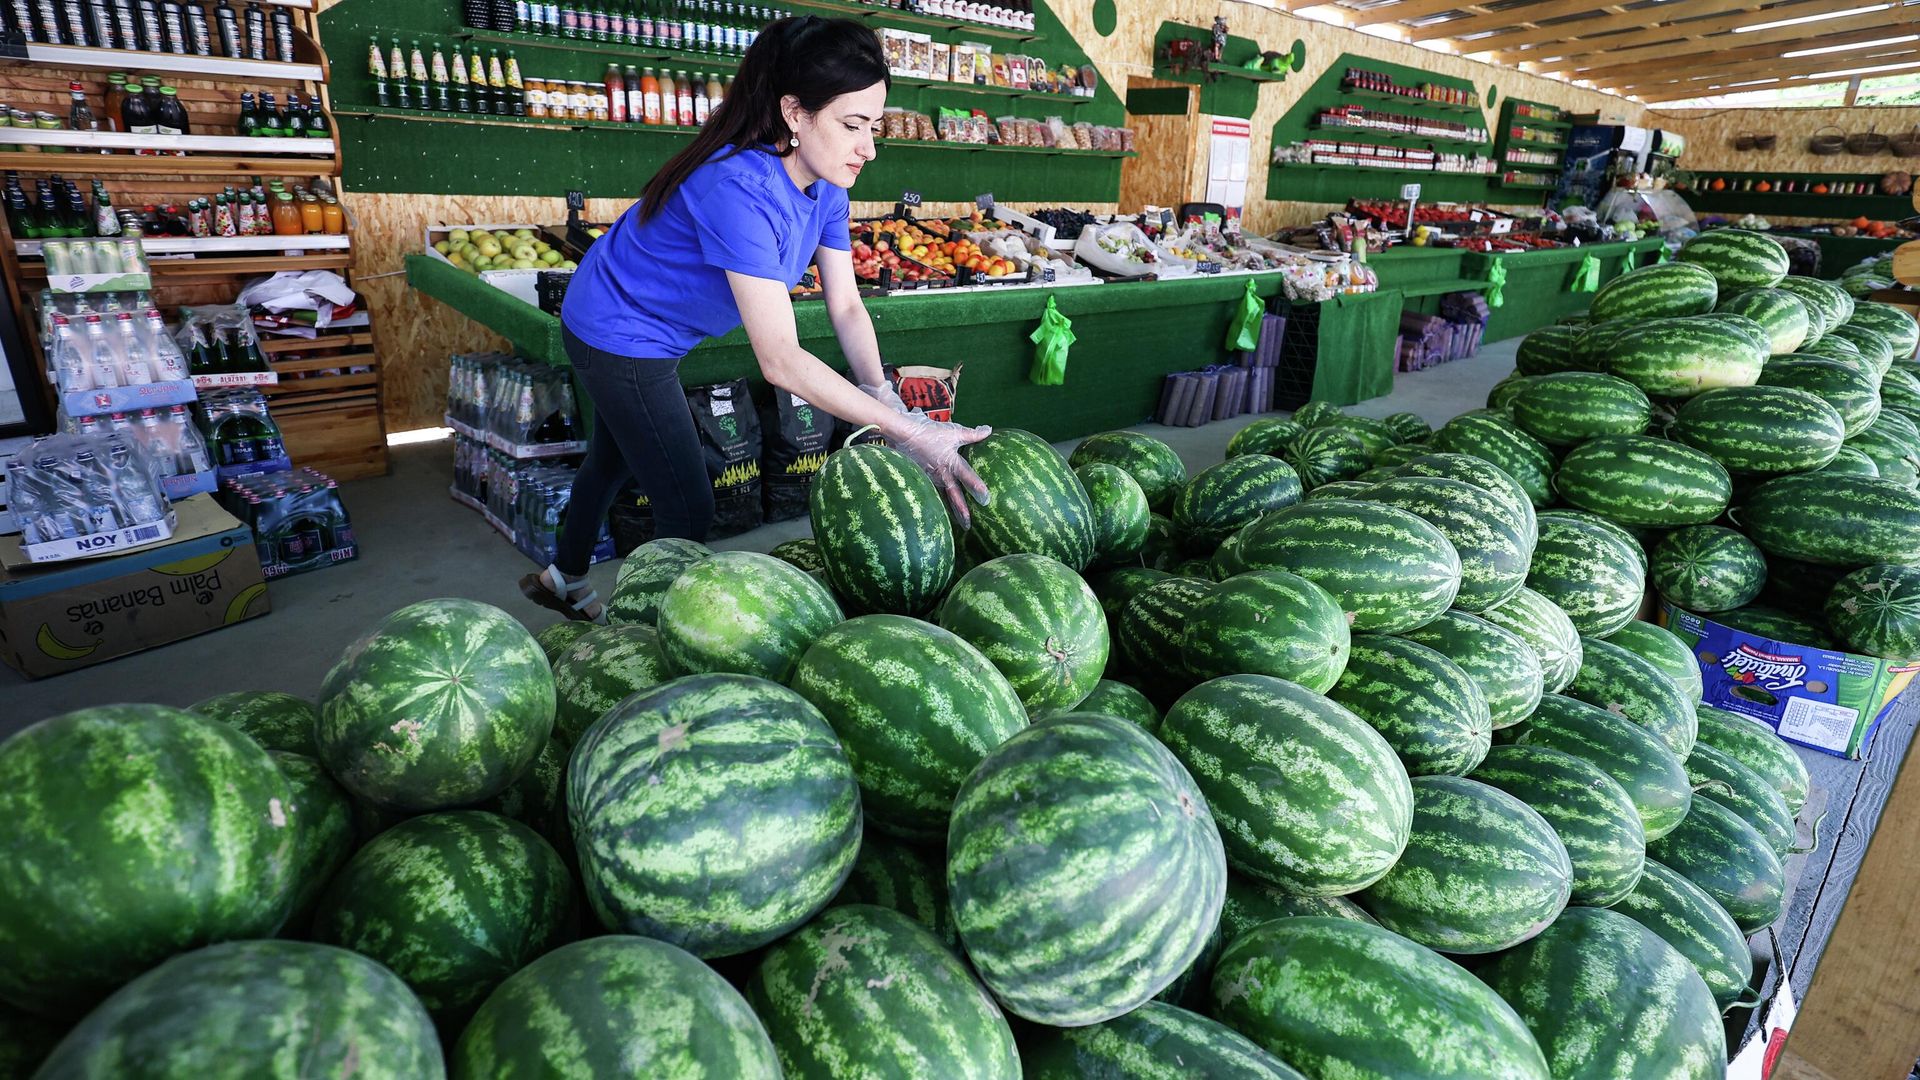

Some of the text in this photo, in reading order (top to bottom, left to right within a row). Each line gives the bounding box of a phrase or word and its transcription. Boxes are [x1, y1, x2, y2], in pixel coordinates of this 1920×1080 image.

[903, 192, 921, 205] 250
[76, 534, 117, 550] NOY
[66, 569, 222, 623] Palm Bananas
[1721, 651, 1807, 690] Frutadeli
